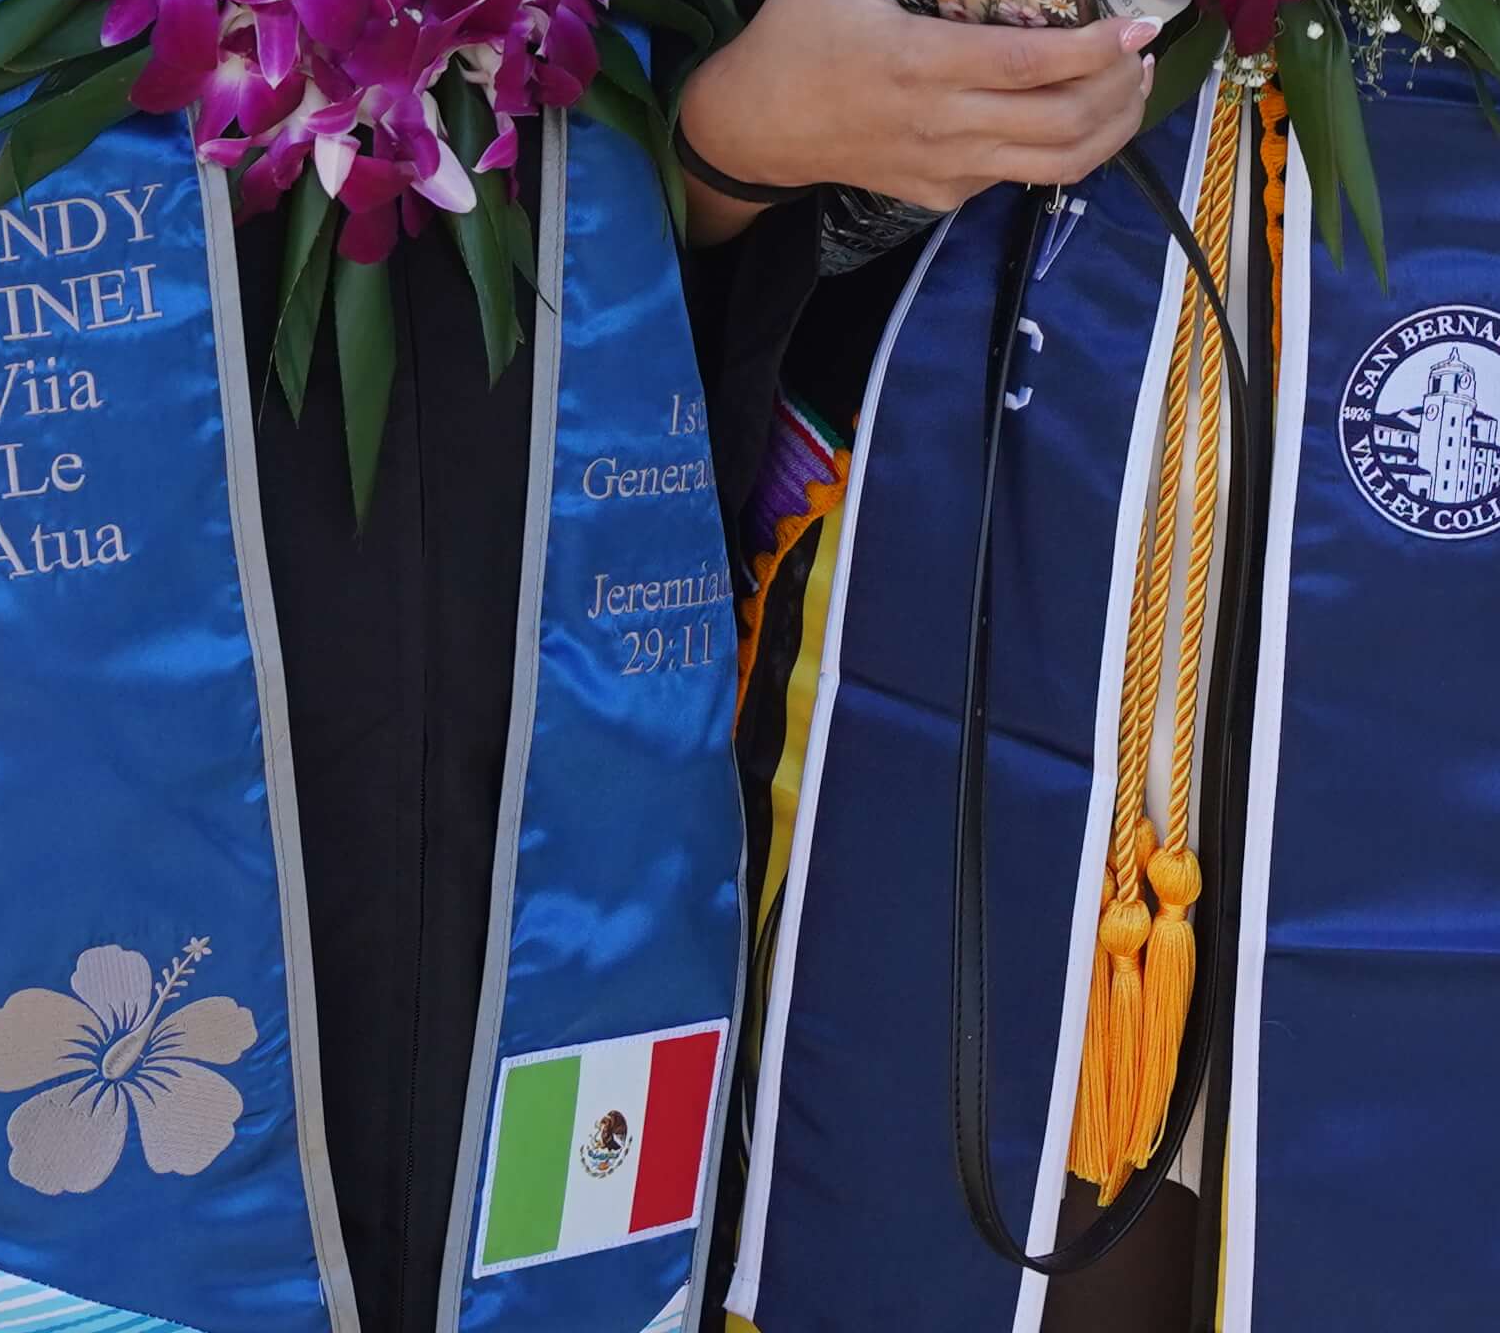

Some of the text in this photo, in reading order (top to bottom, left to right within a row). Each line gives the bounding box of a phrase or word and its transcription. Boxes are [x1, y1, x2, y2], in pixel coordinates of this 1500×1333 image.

[1354, 342, 1398, 400] SAN
[1343, 405, 1372, 422] 1926
[1350, 434, 1430, 524] VALLEY
[621, 621, 713, 676] 29:11
